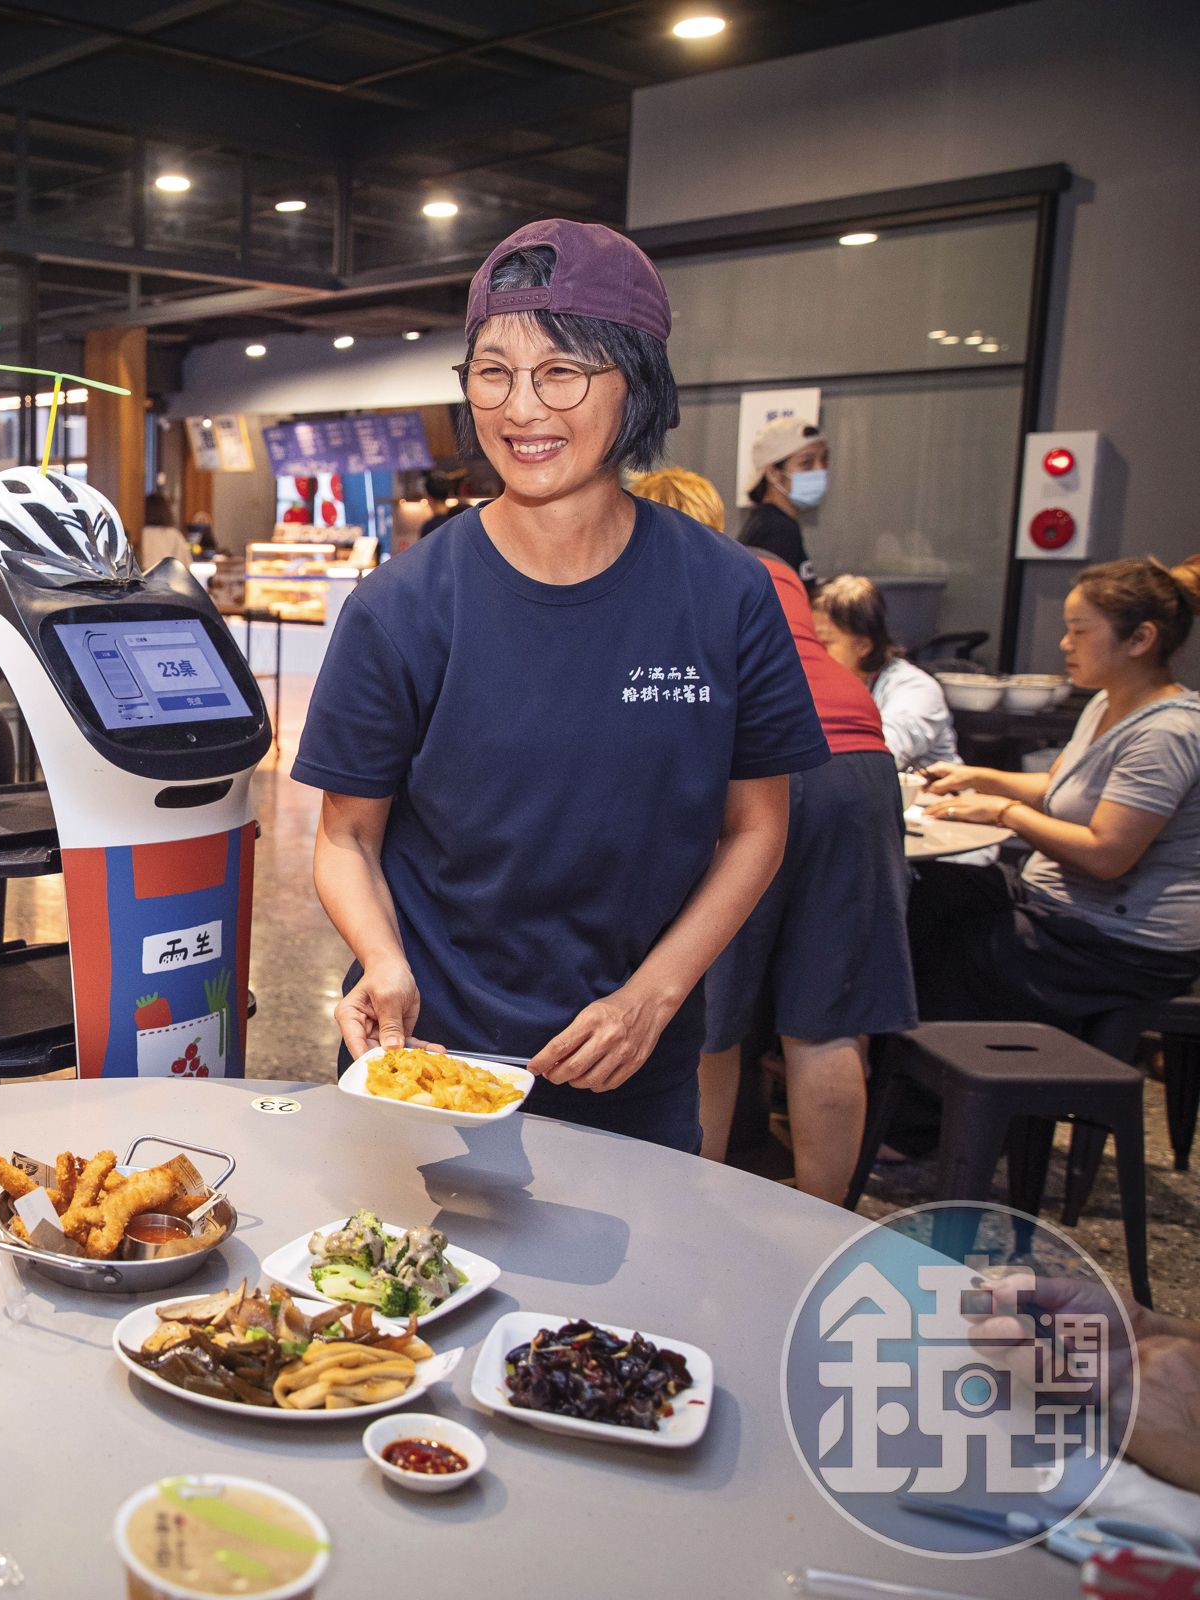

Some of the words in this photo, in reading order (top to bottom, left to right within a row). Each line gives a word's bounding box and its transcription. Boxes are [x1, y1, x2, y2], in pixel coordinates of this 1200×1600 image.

[157, 659, 199, 678] 23桌
[158, 930, 214, 965] 雨生
[260, 1101, 294, 1112] 23
